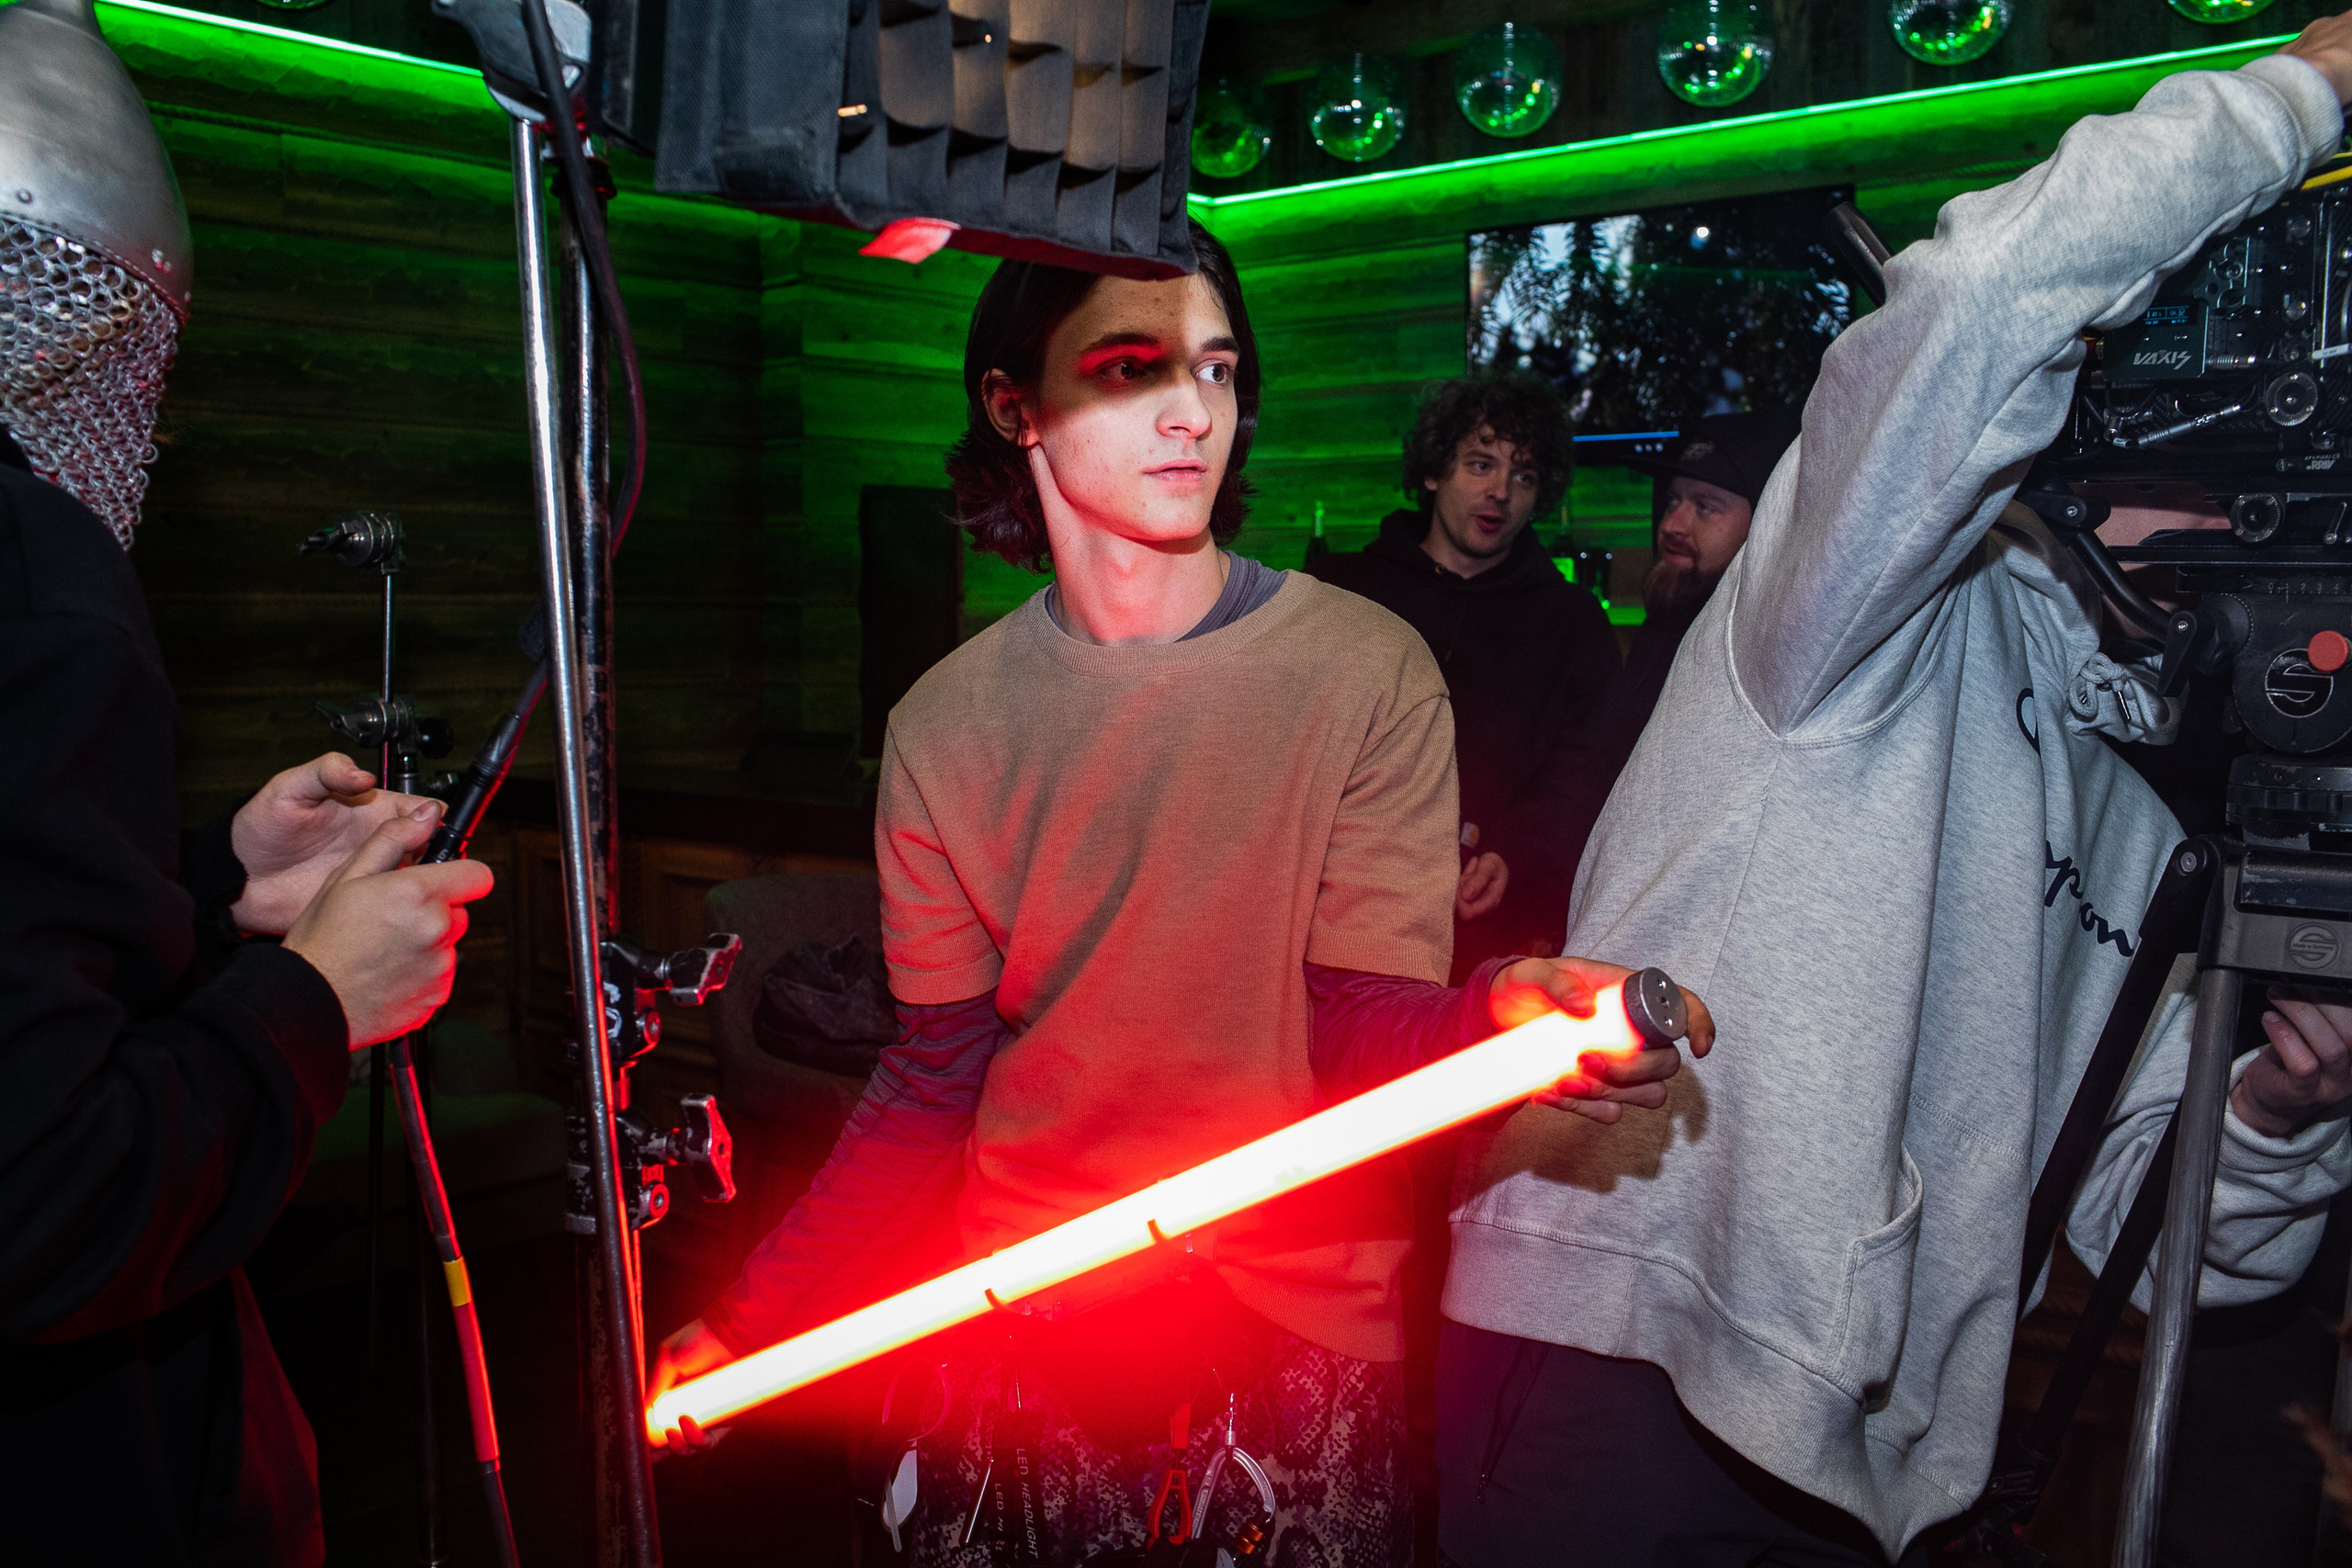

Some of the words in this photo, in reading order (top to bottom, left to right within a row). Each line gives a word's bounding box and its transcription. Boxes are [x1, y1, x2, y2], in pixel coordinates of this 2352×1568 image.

[2132, 350, 2192, 370] VAXIS
[994, 1483, 1004, 1511] LED
[1021, 1481, 1039, 1560] HEADLIGHT
